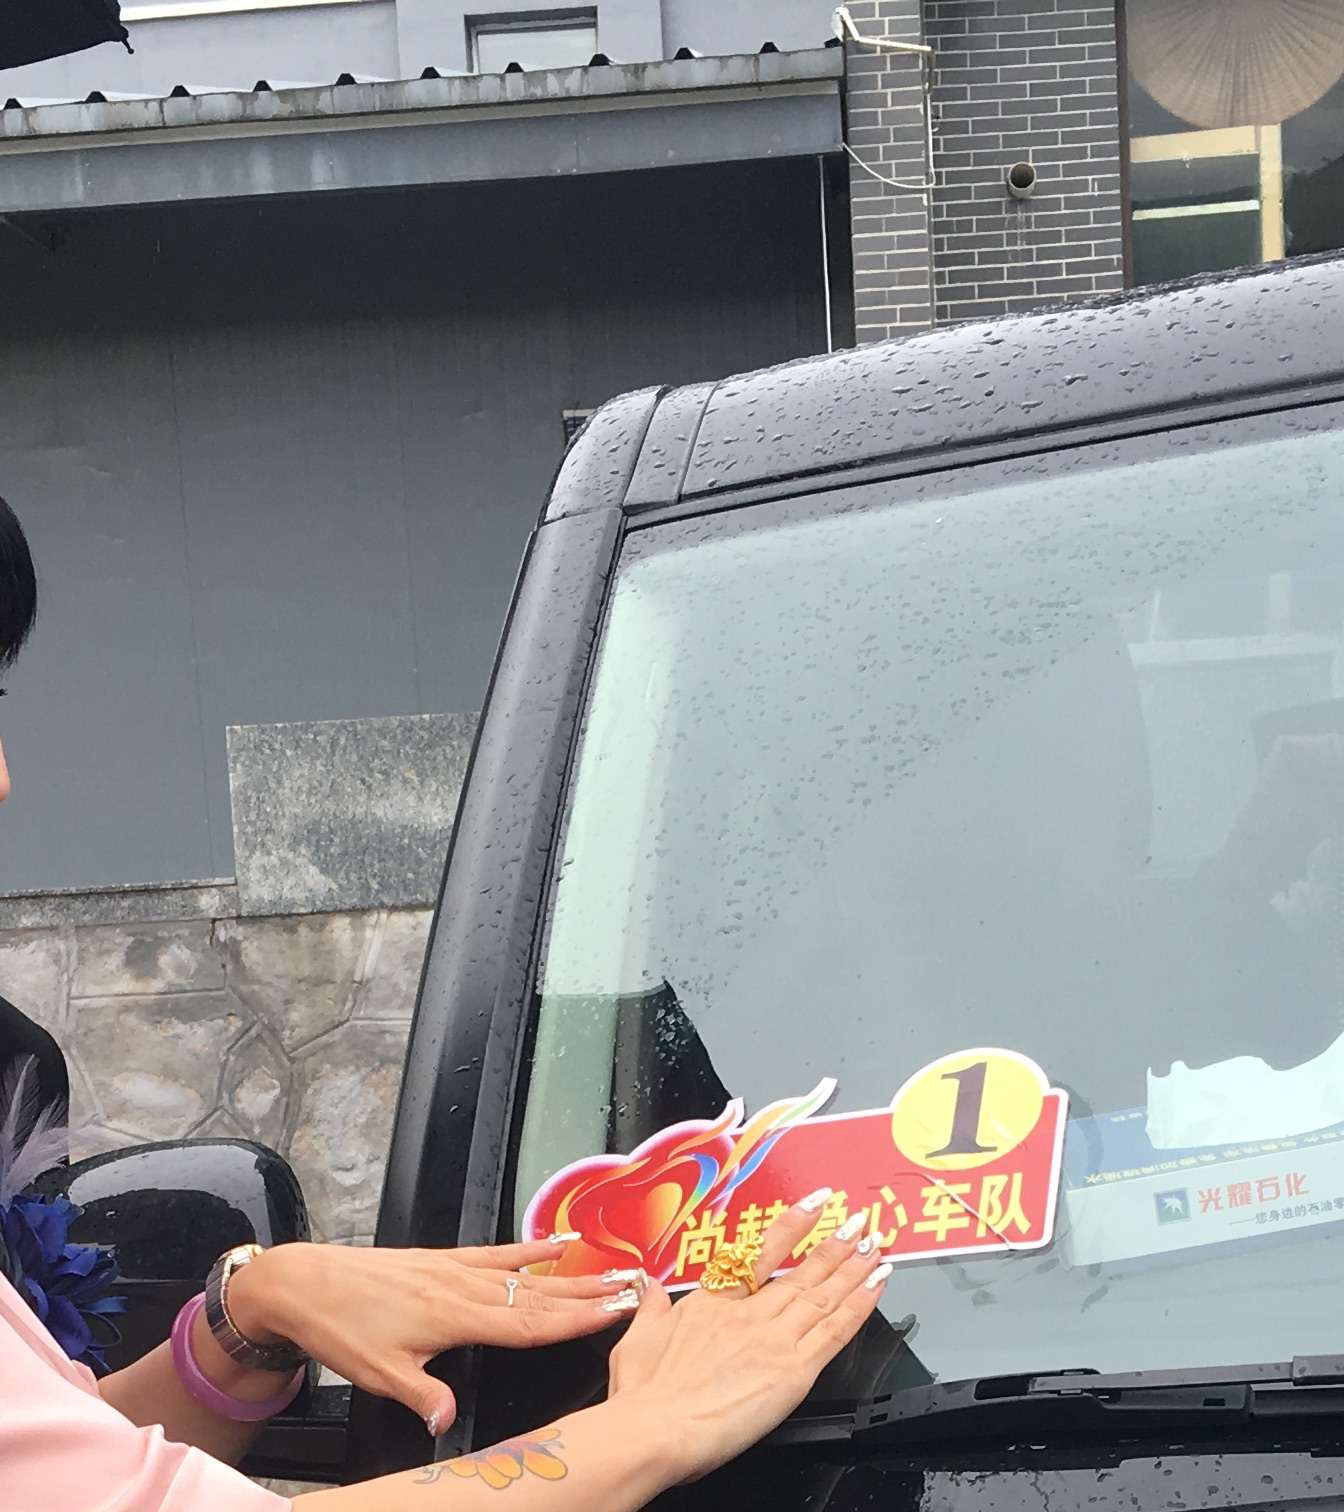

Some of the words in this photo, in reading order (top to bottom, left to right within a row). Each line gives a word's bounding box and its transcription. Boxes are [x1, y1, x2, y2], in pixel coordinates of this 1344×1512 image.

[925, 1061, 998, 1159] 1
[1198, 1172, 1310, 1214] 光耀石化
